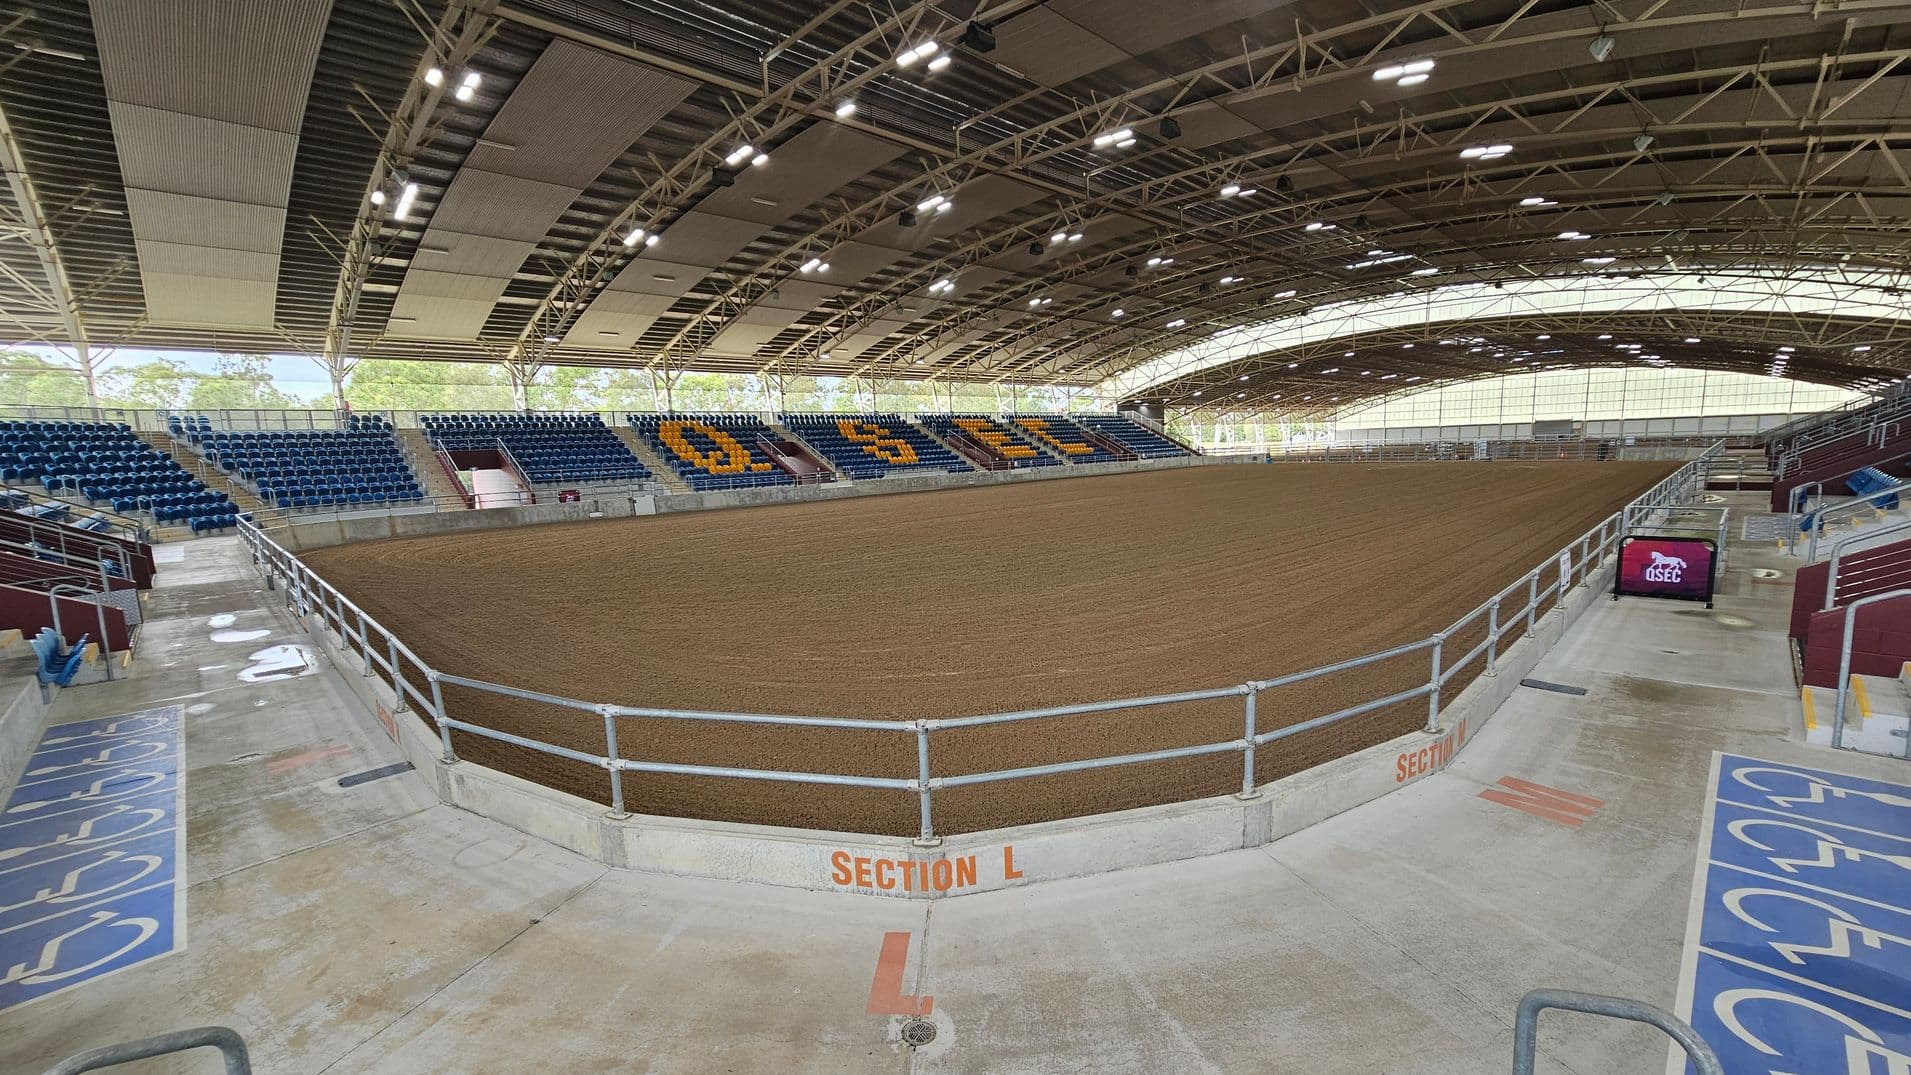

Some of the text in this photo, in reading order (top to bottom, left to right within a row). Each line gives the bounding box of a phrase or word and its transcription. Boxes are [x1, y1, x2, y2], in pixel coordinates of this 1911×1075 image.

[1645, 567, 1682, 583] QSEC
[1395, 734, 1454, 783] SECTION
[831, 845, 1024, 892] SECTION L
[867, 931, 934, 1016] L
